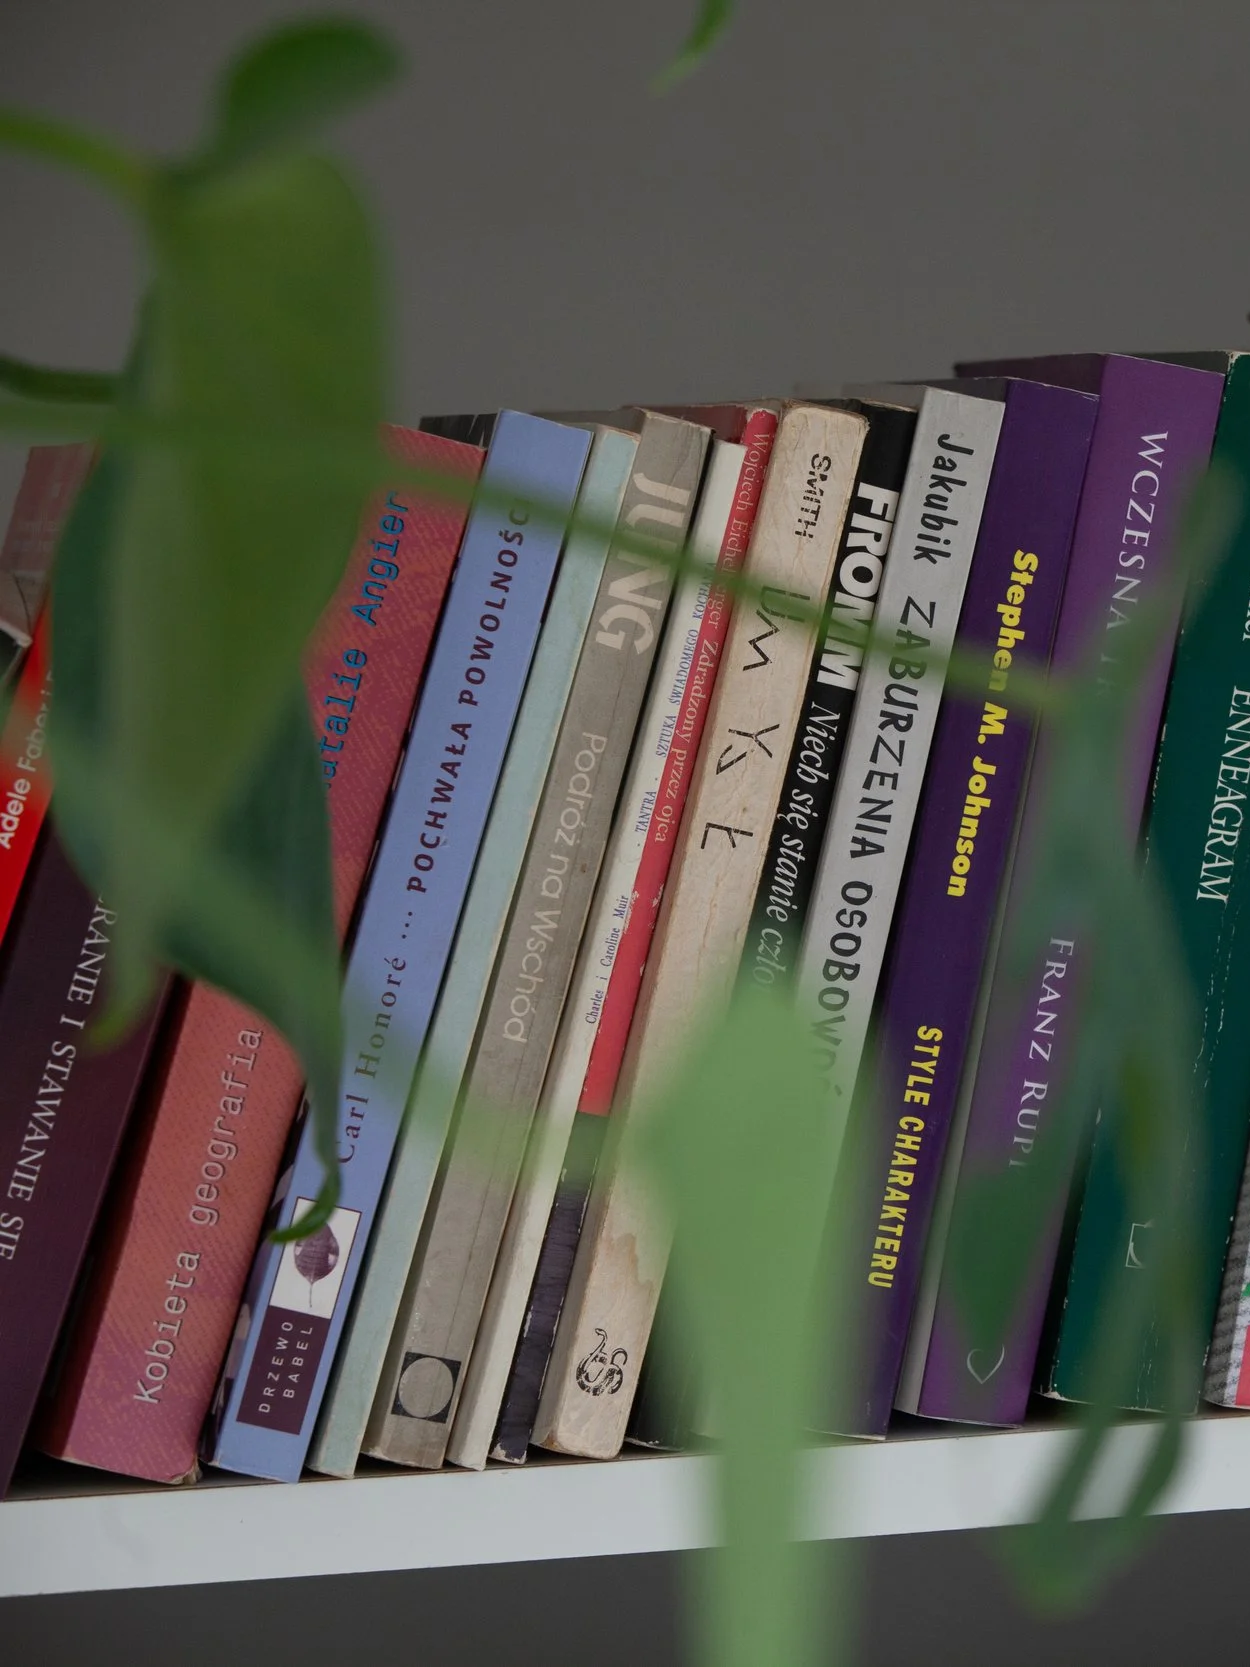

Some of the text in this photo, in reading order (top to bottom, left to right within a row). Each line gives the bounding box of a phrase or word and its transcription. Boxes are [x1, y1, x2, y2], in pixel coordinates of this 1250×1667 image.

[595, 470, 692, 656] JUNG
[795, 452, 832, 540] SMITH
[913, 432, 975, 565] Jakubik
[1106, 431, 1168, 630] WCZESNA
[319, 490, 409, 790] atalie Angier
[654, 432, 770, 842] Wojciech Eichelerger Zdradzony przez ojca
[815, 480, 900, 690] FROMM
[634, 790, 658, 834] TANTRA
[654, 714, 678, 758] SZTUKA
[667, 628, 699, 705] ŚWIADOMEGO
[797, 700, 842, 784] Niech
[850, 594, 935, 860] ZABURZENIA
[947, 550, 1040, 897] Stephen M. Johnson
[0, 778, 31, 849] Adele
[502, 732, 607, 1043] Podróż na Wschód
[765, 832, 806, 923] stanie
[777, 787, 816, 830] się
[60, 1014, 85, 1029] I
[67, 895, 118, 1004] RANIE
[336, 1092, 370, 1165] Carl
[354, 955, 407, 1080] Honoré
[407, 720, 473, 893] POCHWAŁA
[585, 988, 605, 1024] Charles
[600, 926, 620, 967] Caroline
[613, 895, 630, 919] Muir
[1027, 937, 1074, 1062] FRANZ
[7, 1040, 76, 1201] STAWANIE
[867, 1024, 943, 1290] STYLE CHARAKTERU
[134, 1028, 263, 1403] Kobieta geografia
[258, 1320, 294, 1414] DRZEWO
[283, 1326, 314, 1399] BABEL
